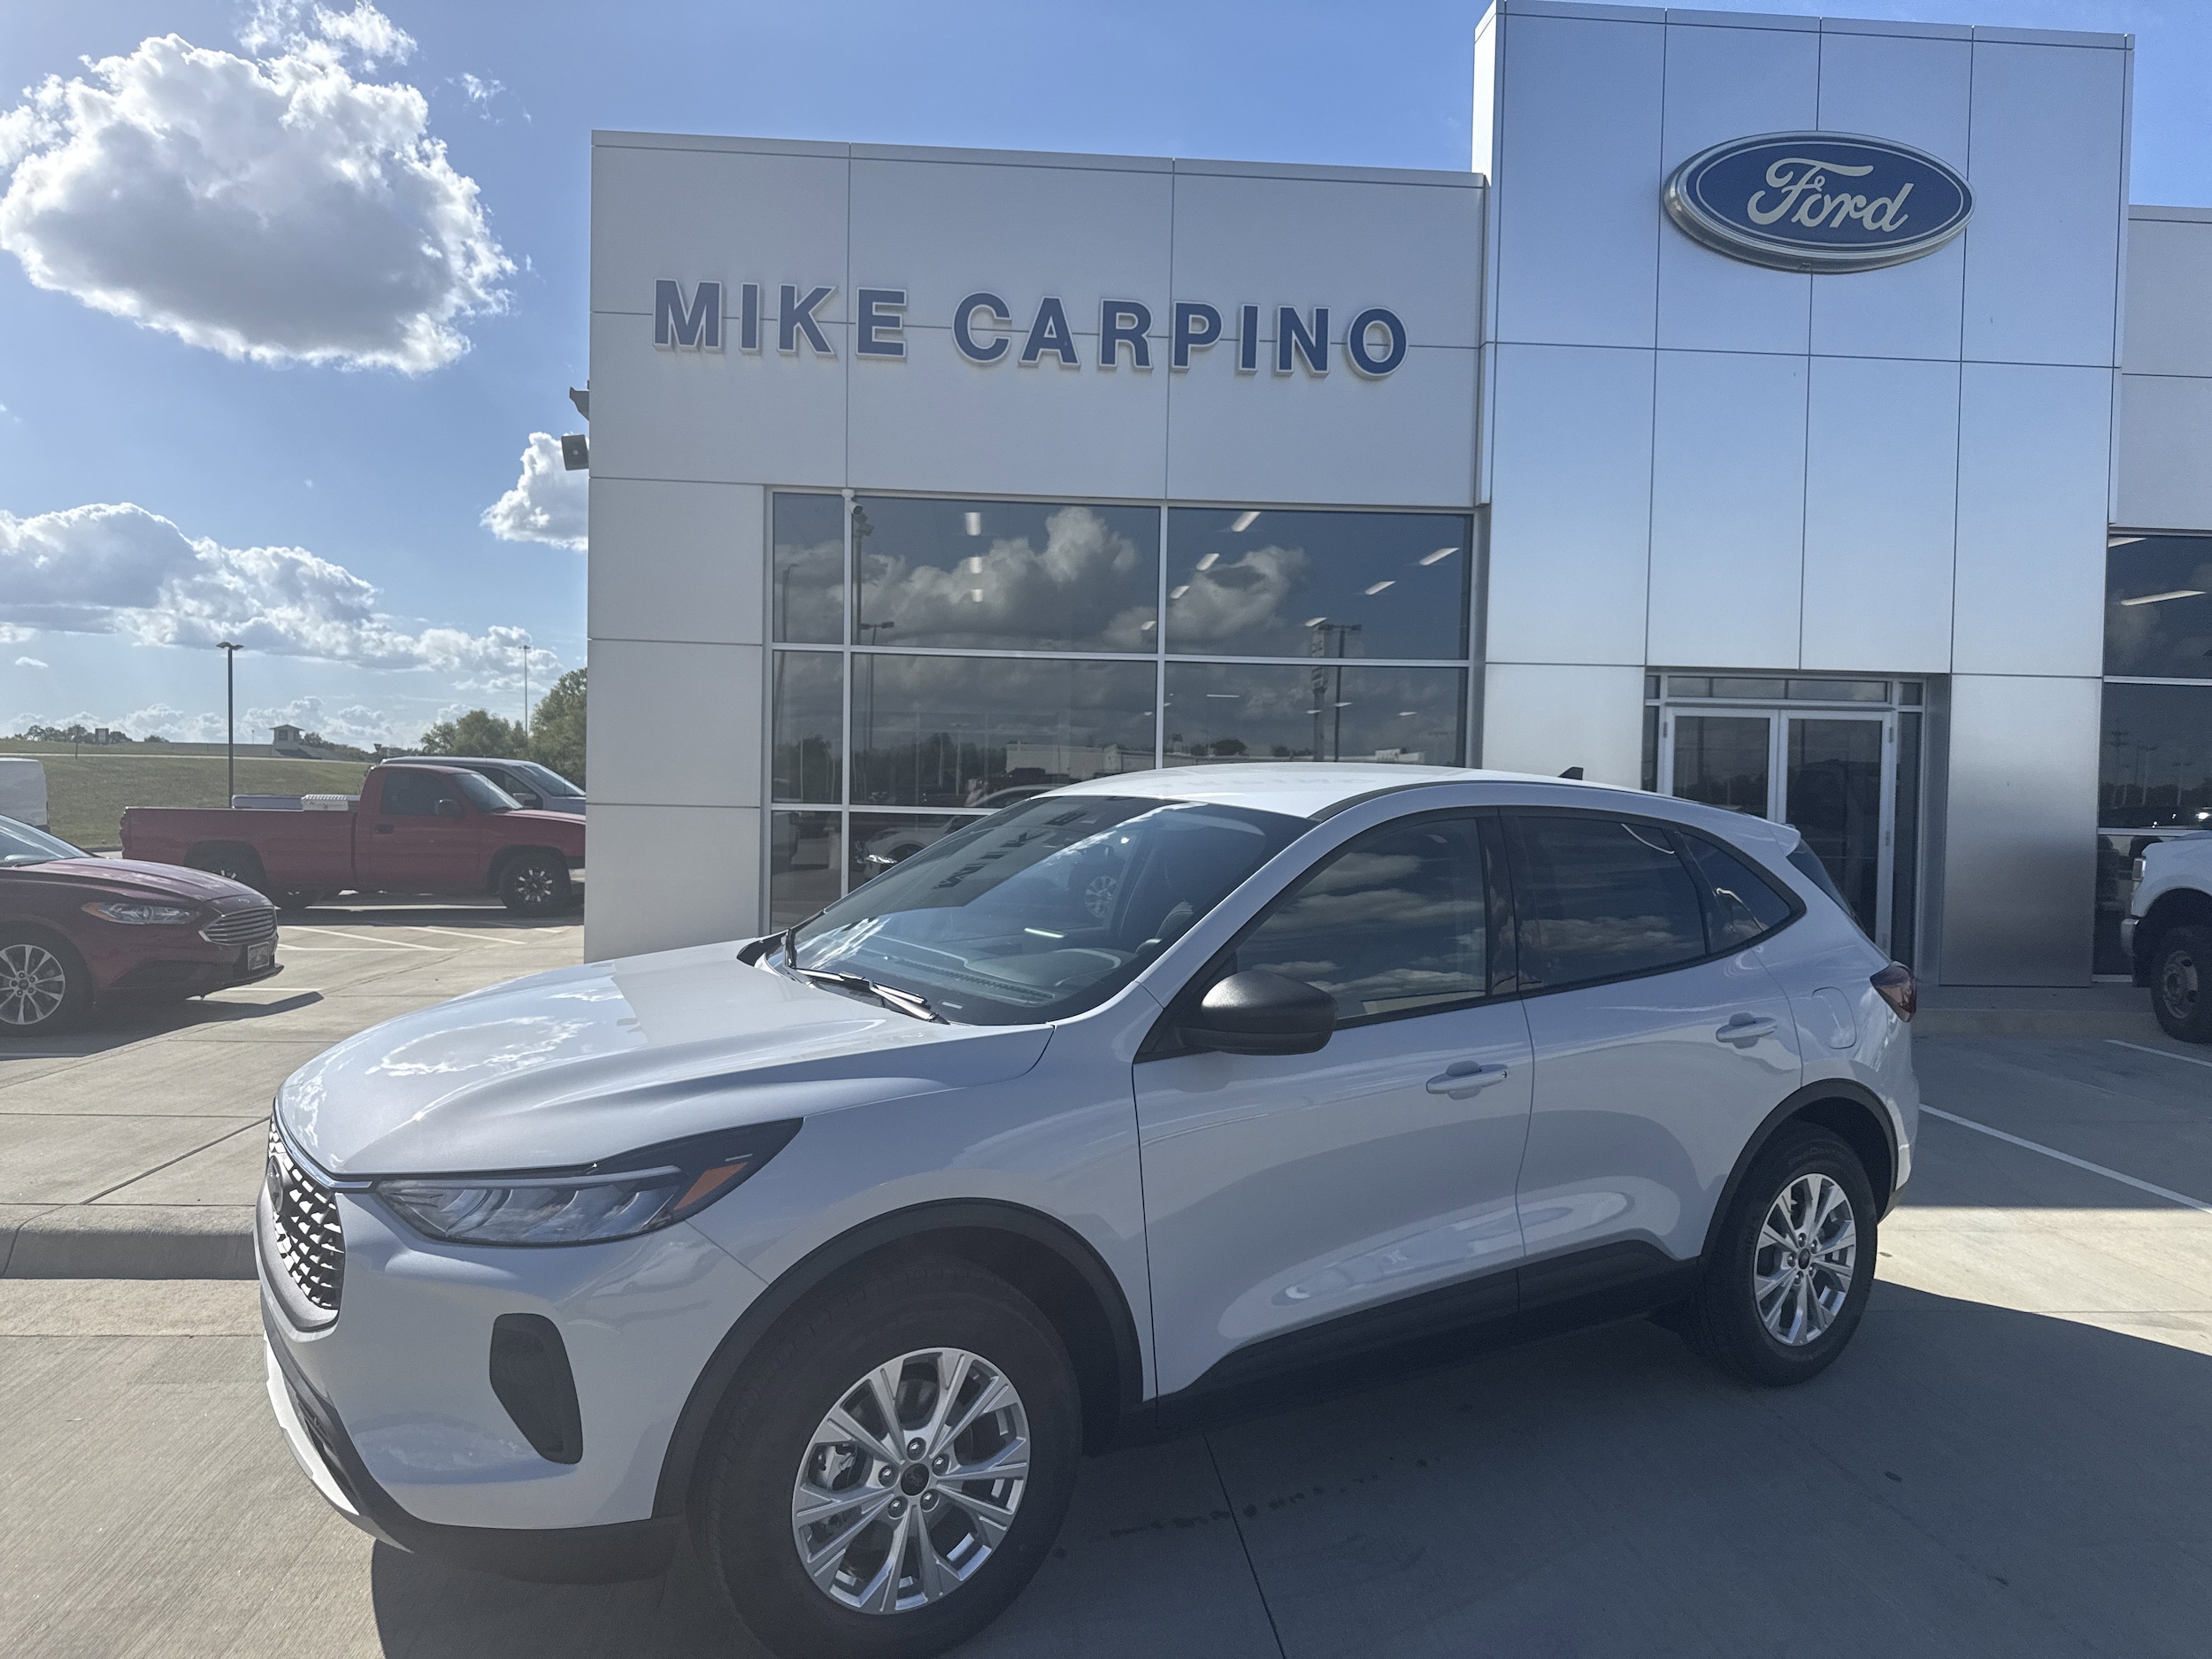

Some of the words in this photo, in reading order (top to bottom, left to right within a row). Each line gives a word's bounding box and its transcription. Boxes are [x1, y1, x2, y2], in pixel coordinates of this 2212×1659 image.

[1747, 157, 1914, 233] Ford
[653, 279, 907, 357] MIKE
[951, 290, 1410, 380] CARPINO
